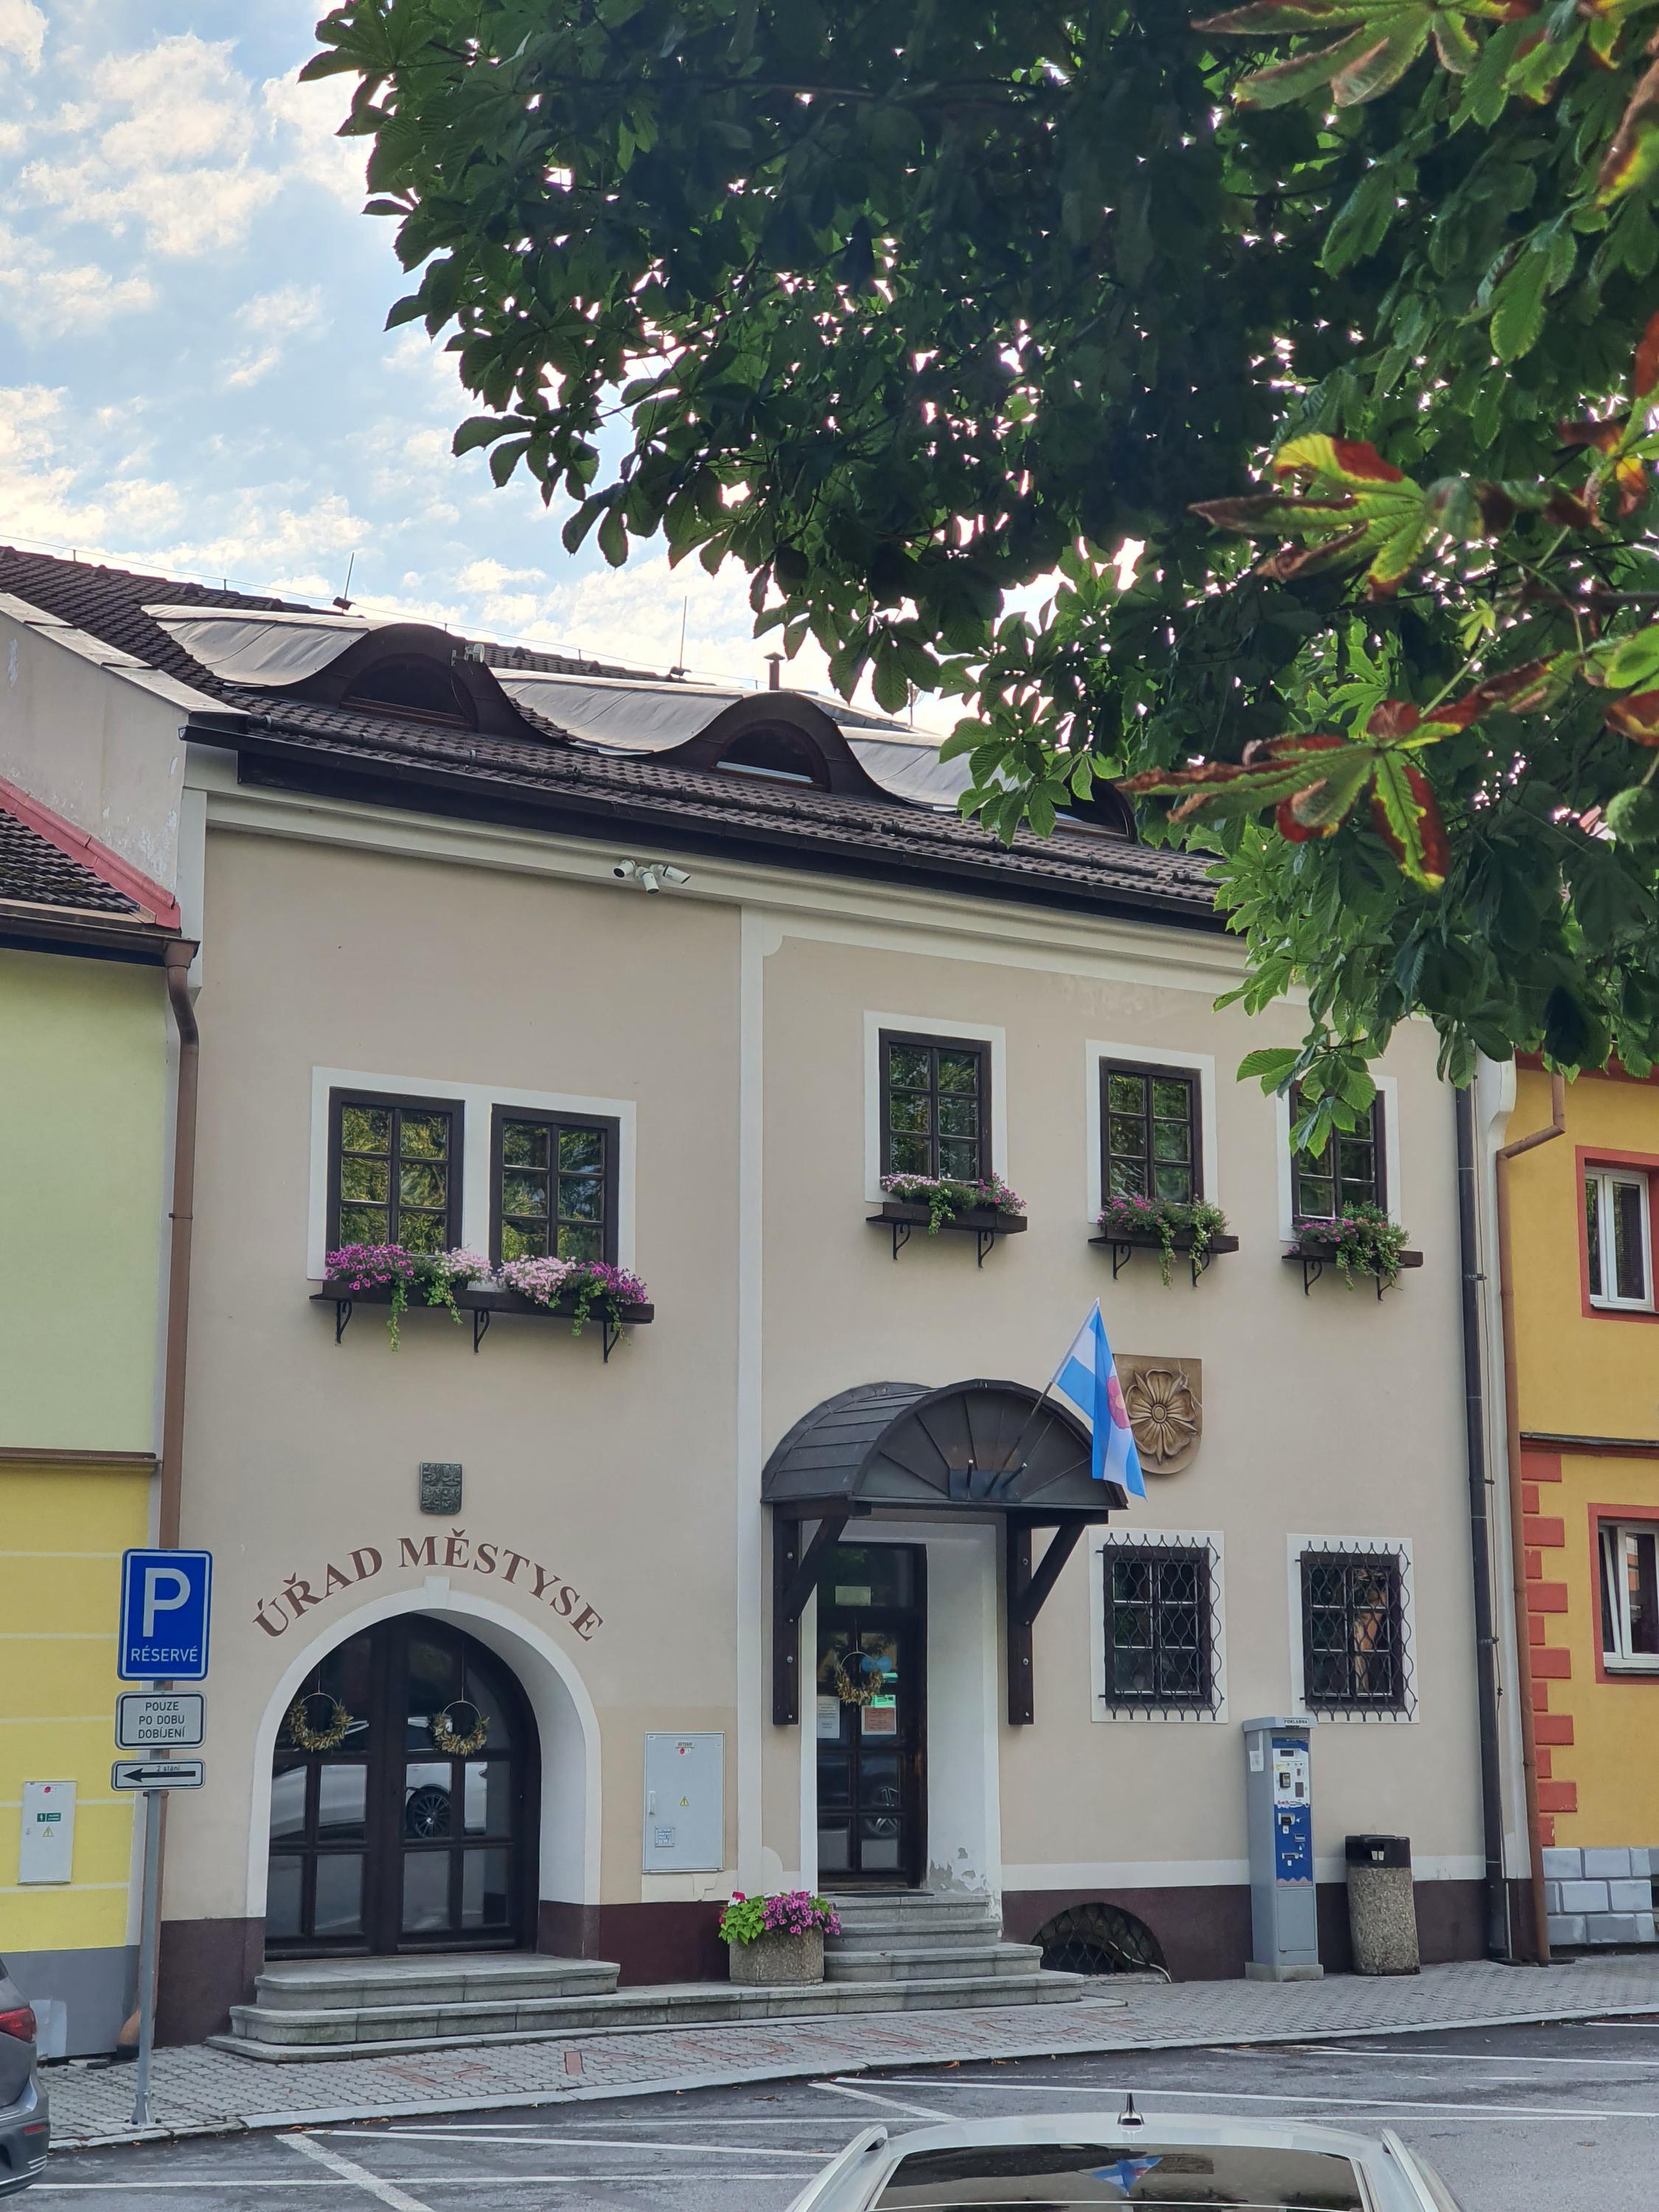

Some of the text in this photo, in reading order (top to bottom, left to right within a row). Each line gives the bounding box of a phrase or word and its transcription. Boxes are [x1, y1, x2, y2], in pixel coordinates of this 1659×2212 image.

[252, 1527, 604, 1642] ÚŘAD MĚSTYSE
[142, 1567, 191, 1638] P
[131, 1645, 198, 1662] RÉSERVÉ
[145, 1701, 179, 1711] POUZE
[139, 1715, 185, 1725] PO DOBU
[138, 1726, 186, 1739] DOBÍJENÍ
